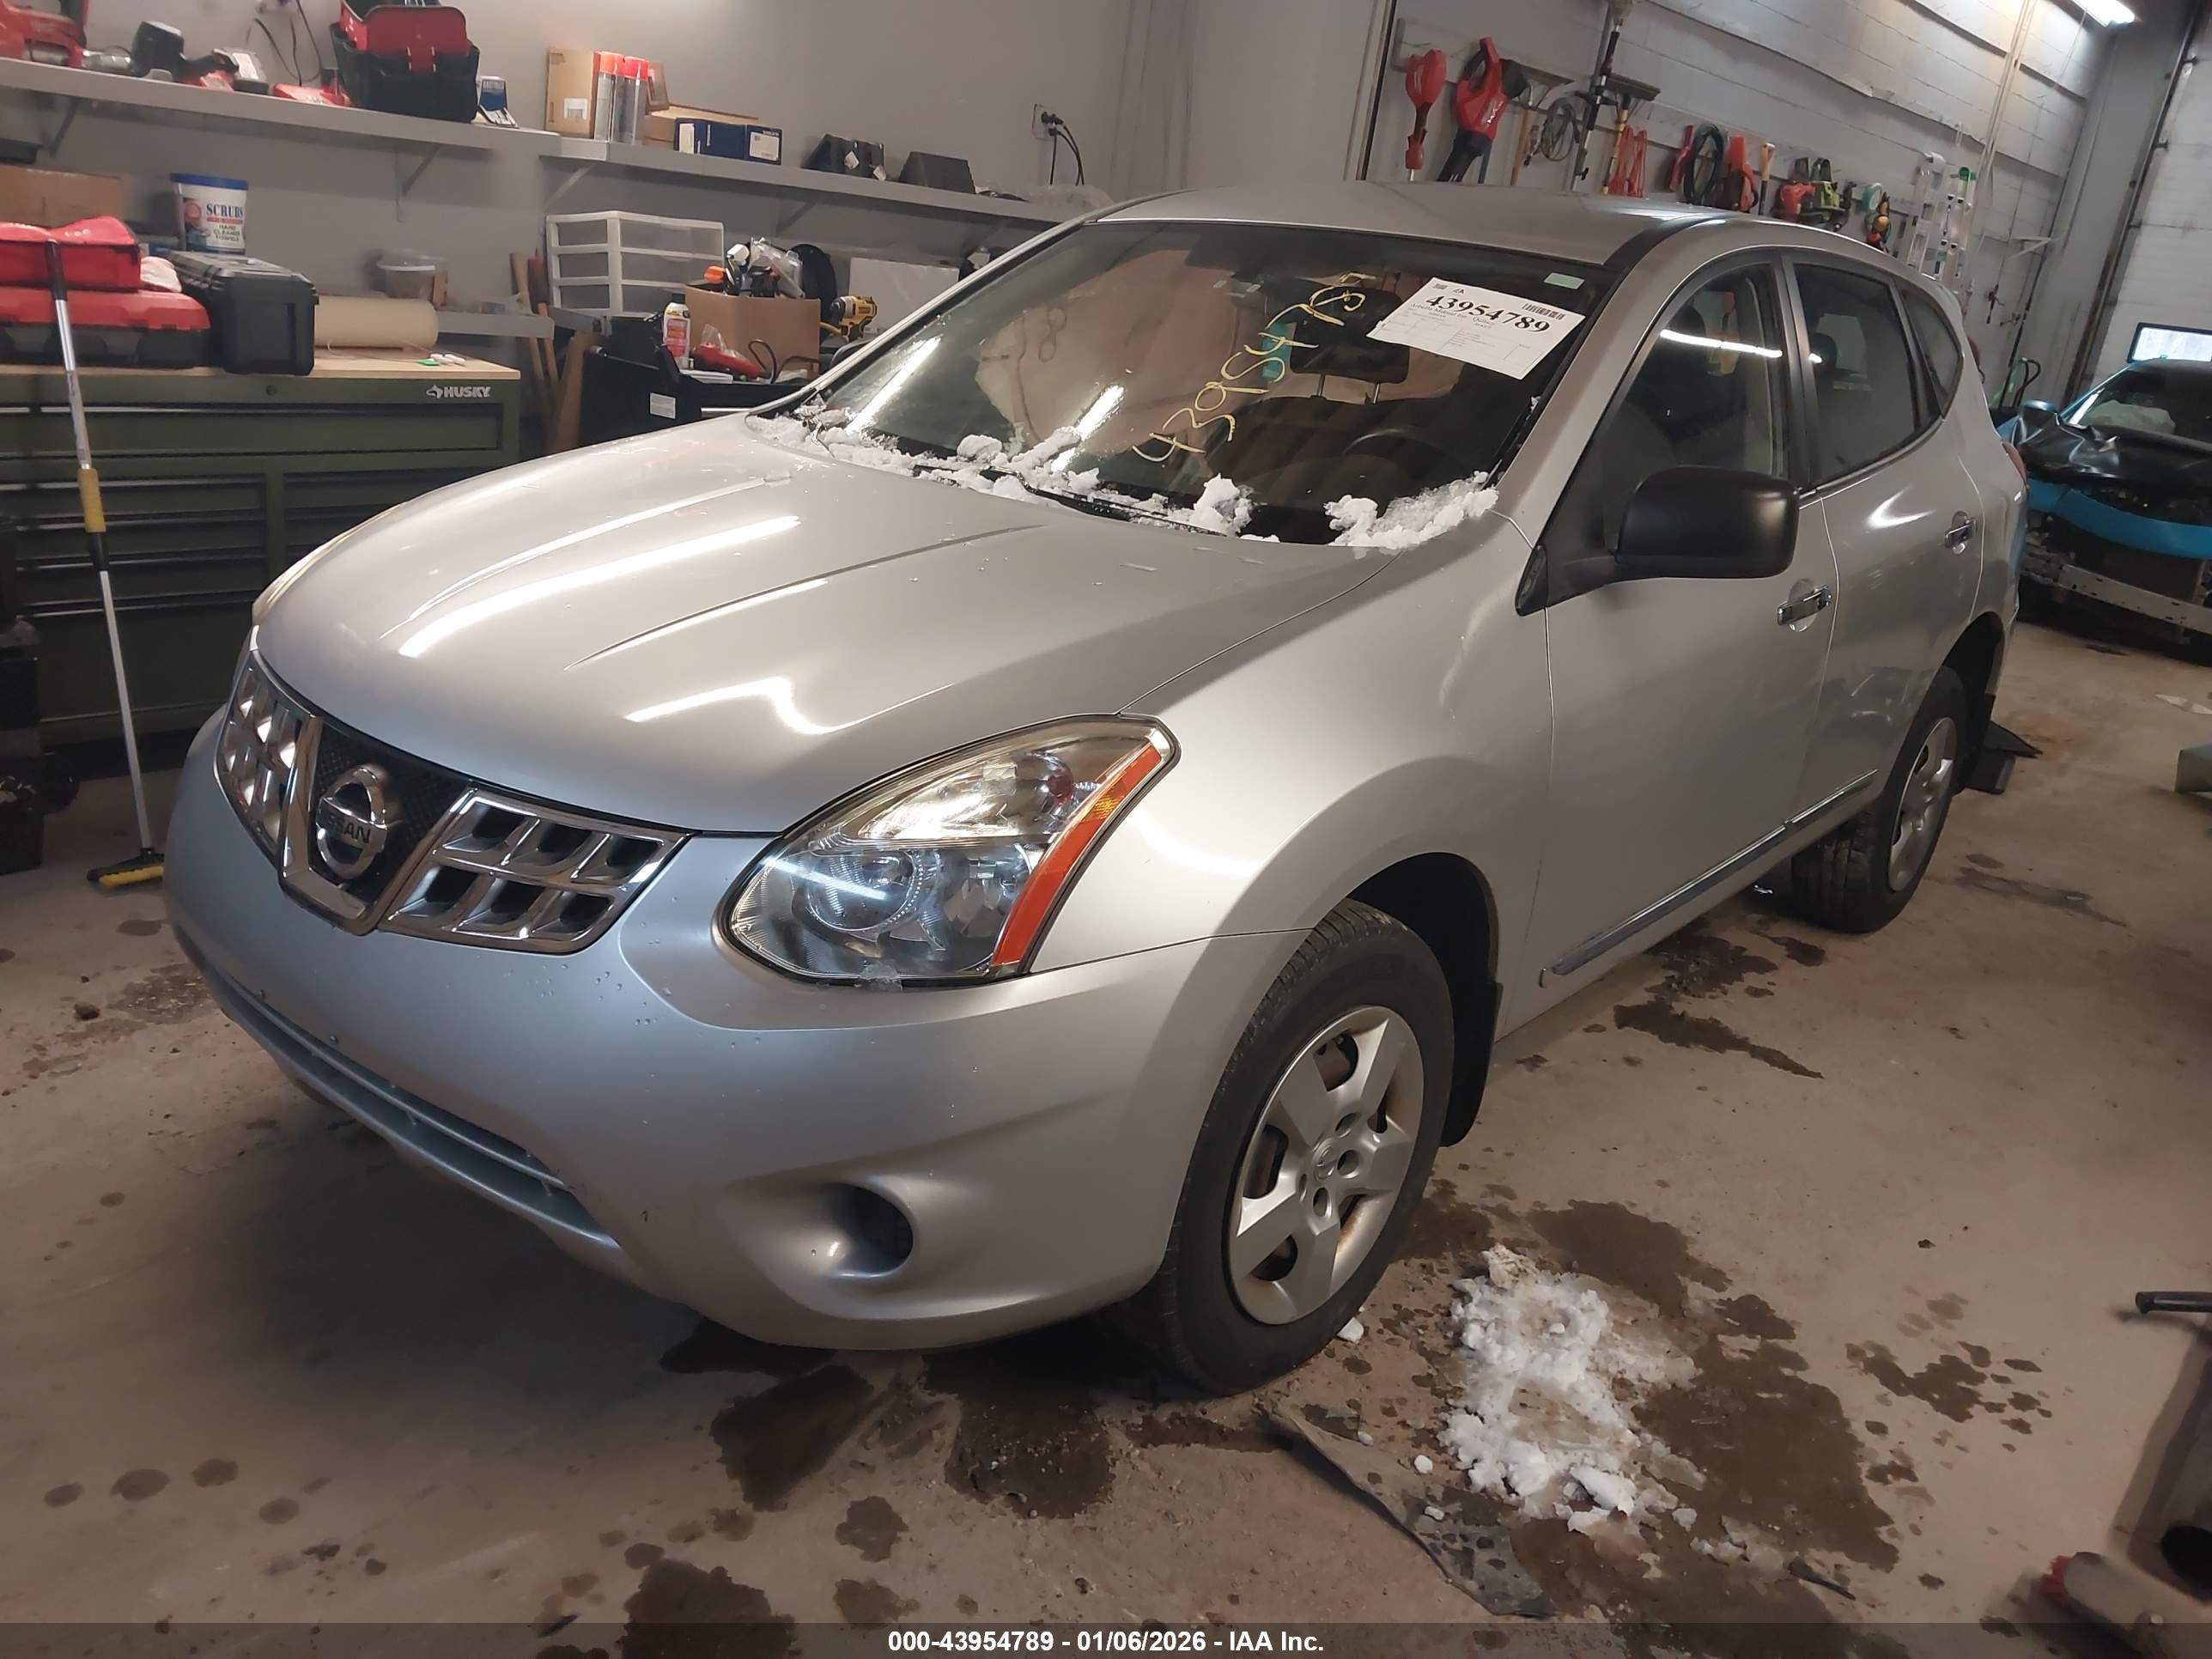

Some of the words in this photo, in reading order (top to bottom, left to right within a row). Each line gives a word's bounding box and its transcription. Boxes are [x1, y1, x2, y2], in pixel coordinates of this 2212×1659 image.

[206, 203, 244, 218] SCRUBS
[1425, 295, 1551, 333] 43954789
[443, 386, 491, 398] HUSKY
